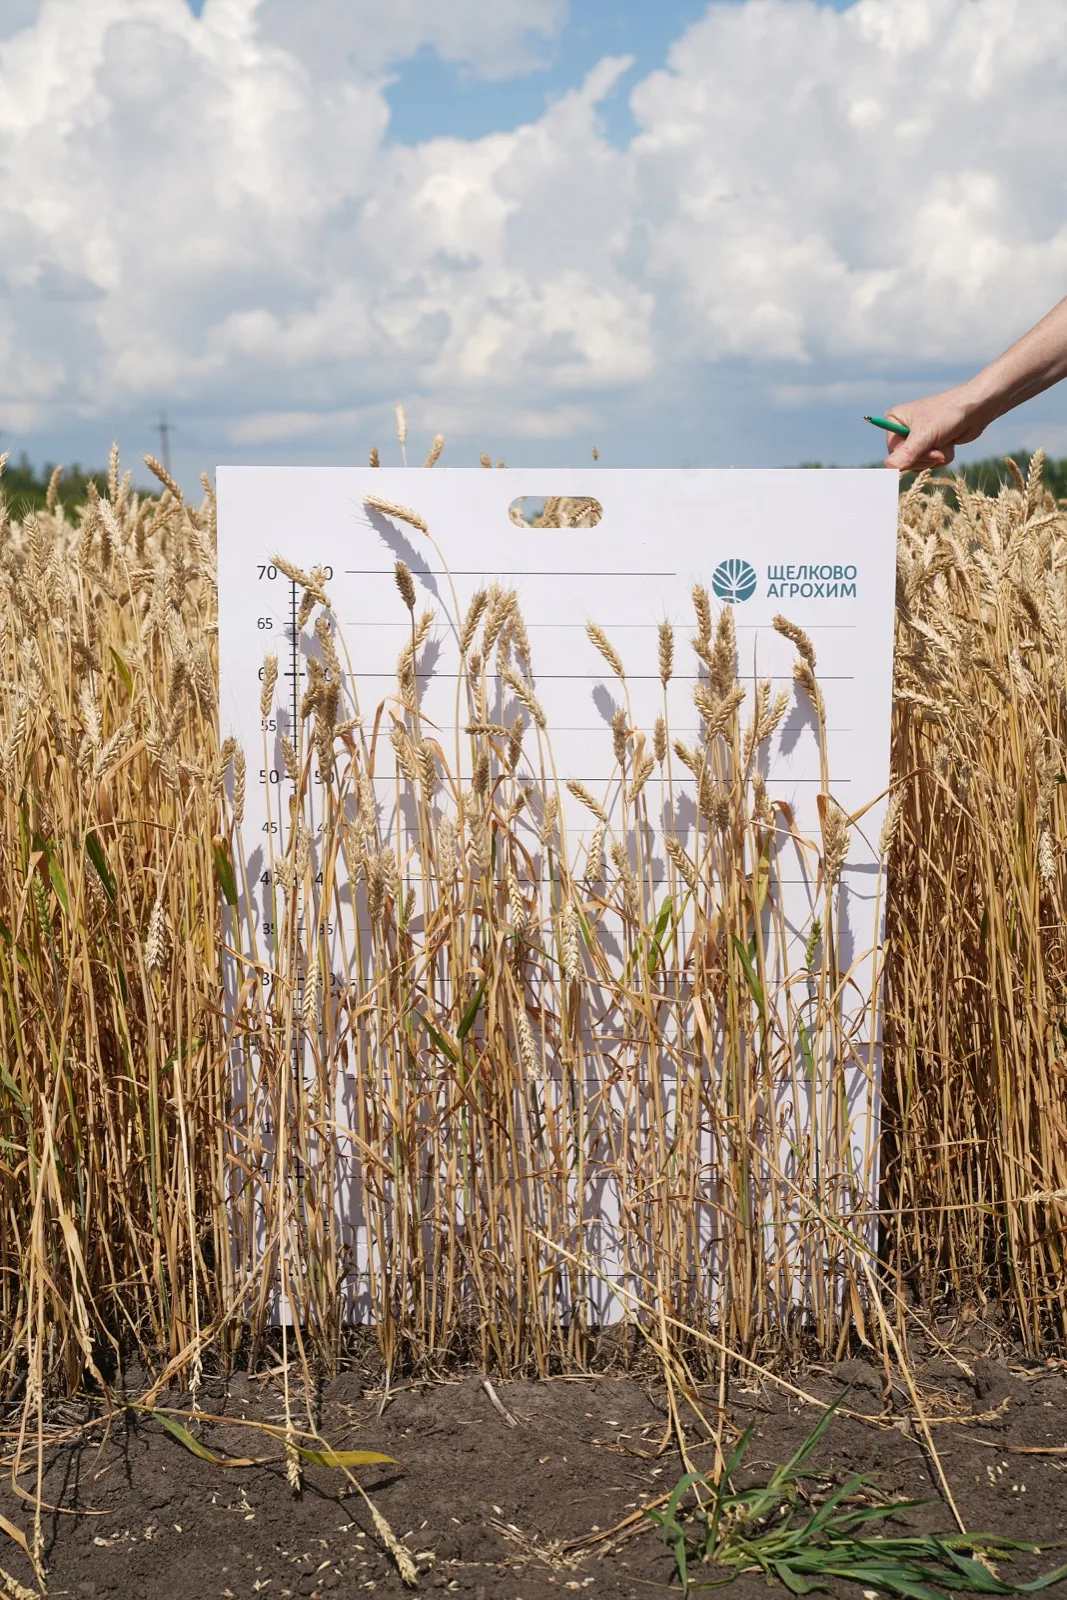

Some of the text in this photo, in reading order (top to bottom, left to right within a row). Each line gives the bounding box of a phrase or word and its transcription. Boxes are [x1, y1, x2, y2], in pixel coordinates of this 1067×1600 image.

[256, 565, 278, 580] 70
[312, 565, 334, 581] 0
[767, 565, 858, 581] ЩЕЛКОВО
[766, 583, 857, 598] АГРОХИМ
[257, 617, 273, 630] 65
[259, 769, 280, 784] 50
[261, 822, 278, 834] 45
[260, 871, 280, 885] 4
